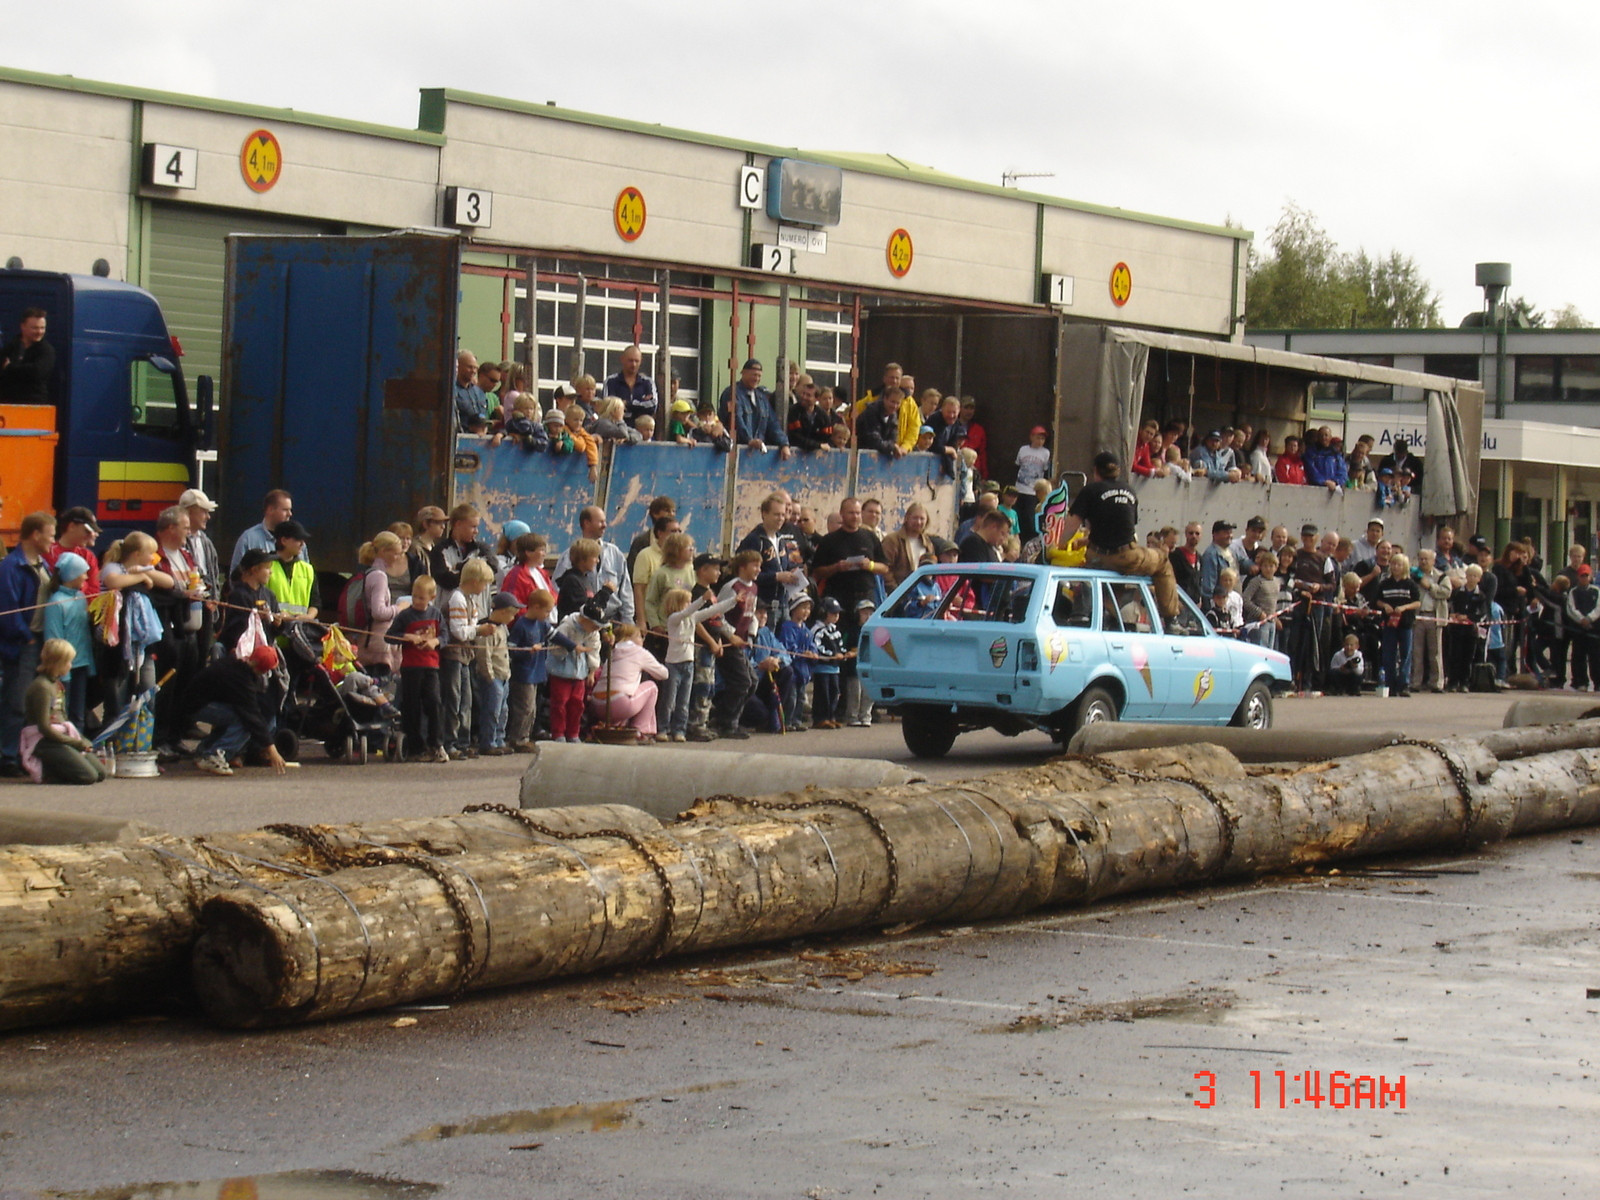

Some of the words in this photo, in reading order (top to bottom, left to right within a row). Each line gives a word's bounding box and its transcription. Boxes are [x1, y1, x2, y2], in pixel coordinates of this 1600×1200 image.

[165, 150, 183, 183] 4
[744, 171, 760, 203] C
[466, 192, 480, 224] 3
[770, 248, 782, 272] 2
[1058, 277, 1064, 302] 1
